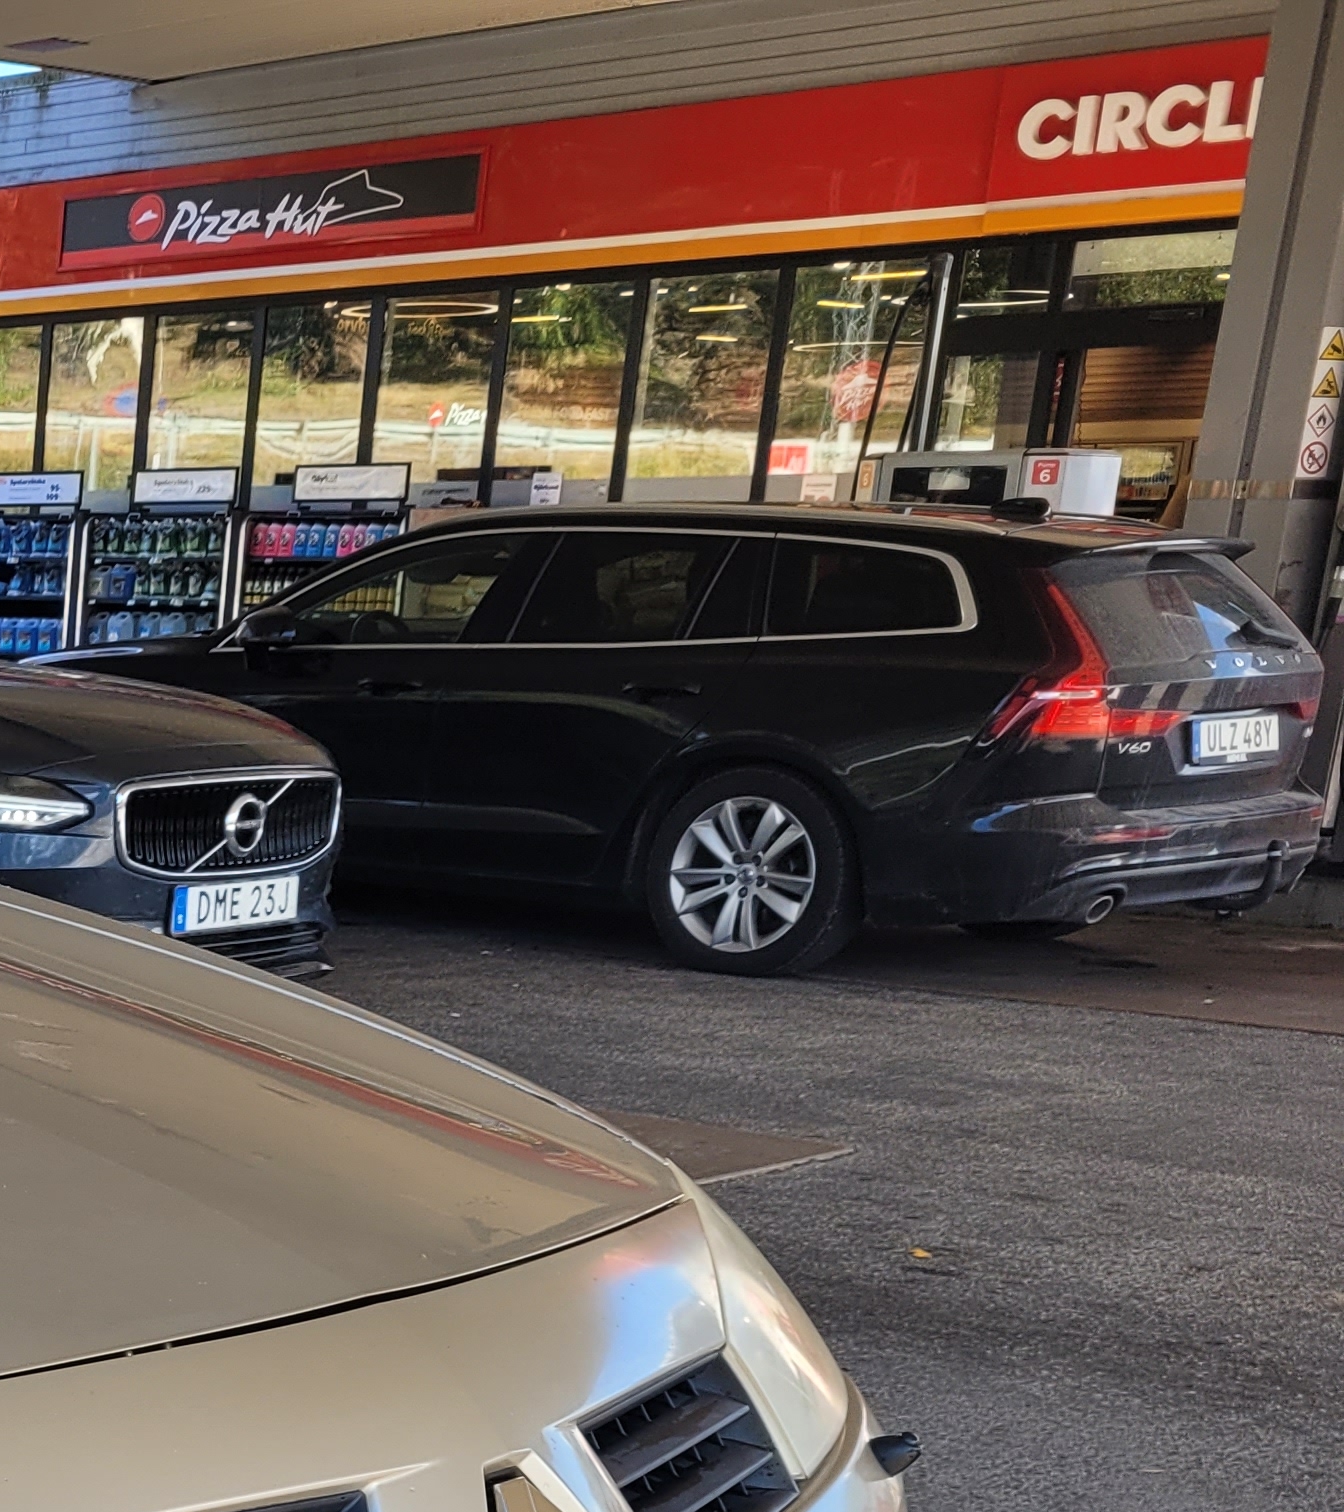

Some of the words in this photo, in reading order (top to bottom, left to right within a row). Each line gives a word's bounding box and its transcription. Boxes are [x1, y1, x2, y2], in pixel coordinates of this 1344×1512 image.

[160, 198, 261, 252] Pizza
[264, 192, 345, 240] Hut
[444, 402, 481, 426] Pizza
[862, 472, 869, 487] 6
[1039, 468, 1051, 483] 6
[1205, 654, 1302, 669] VOLVO
[1206, 722, 1239, 753] ULZ
[1242, 718, 1273, 749] 48Y
[1117, 741, 1152, 755] V60
[196, 887, 242, 925] DME
[249, 881, 290, 919] 23J
[177, 914, 184, 925] S
